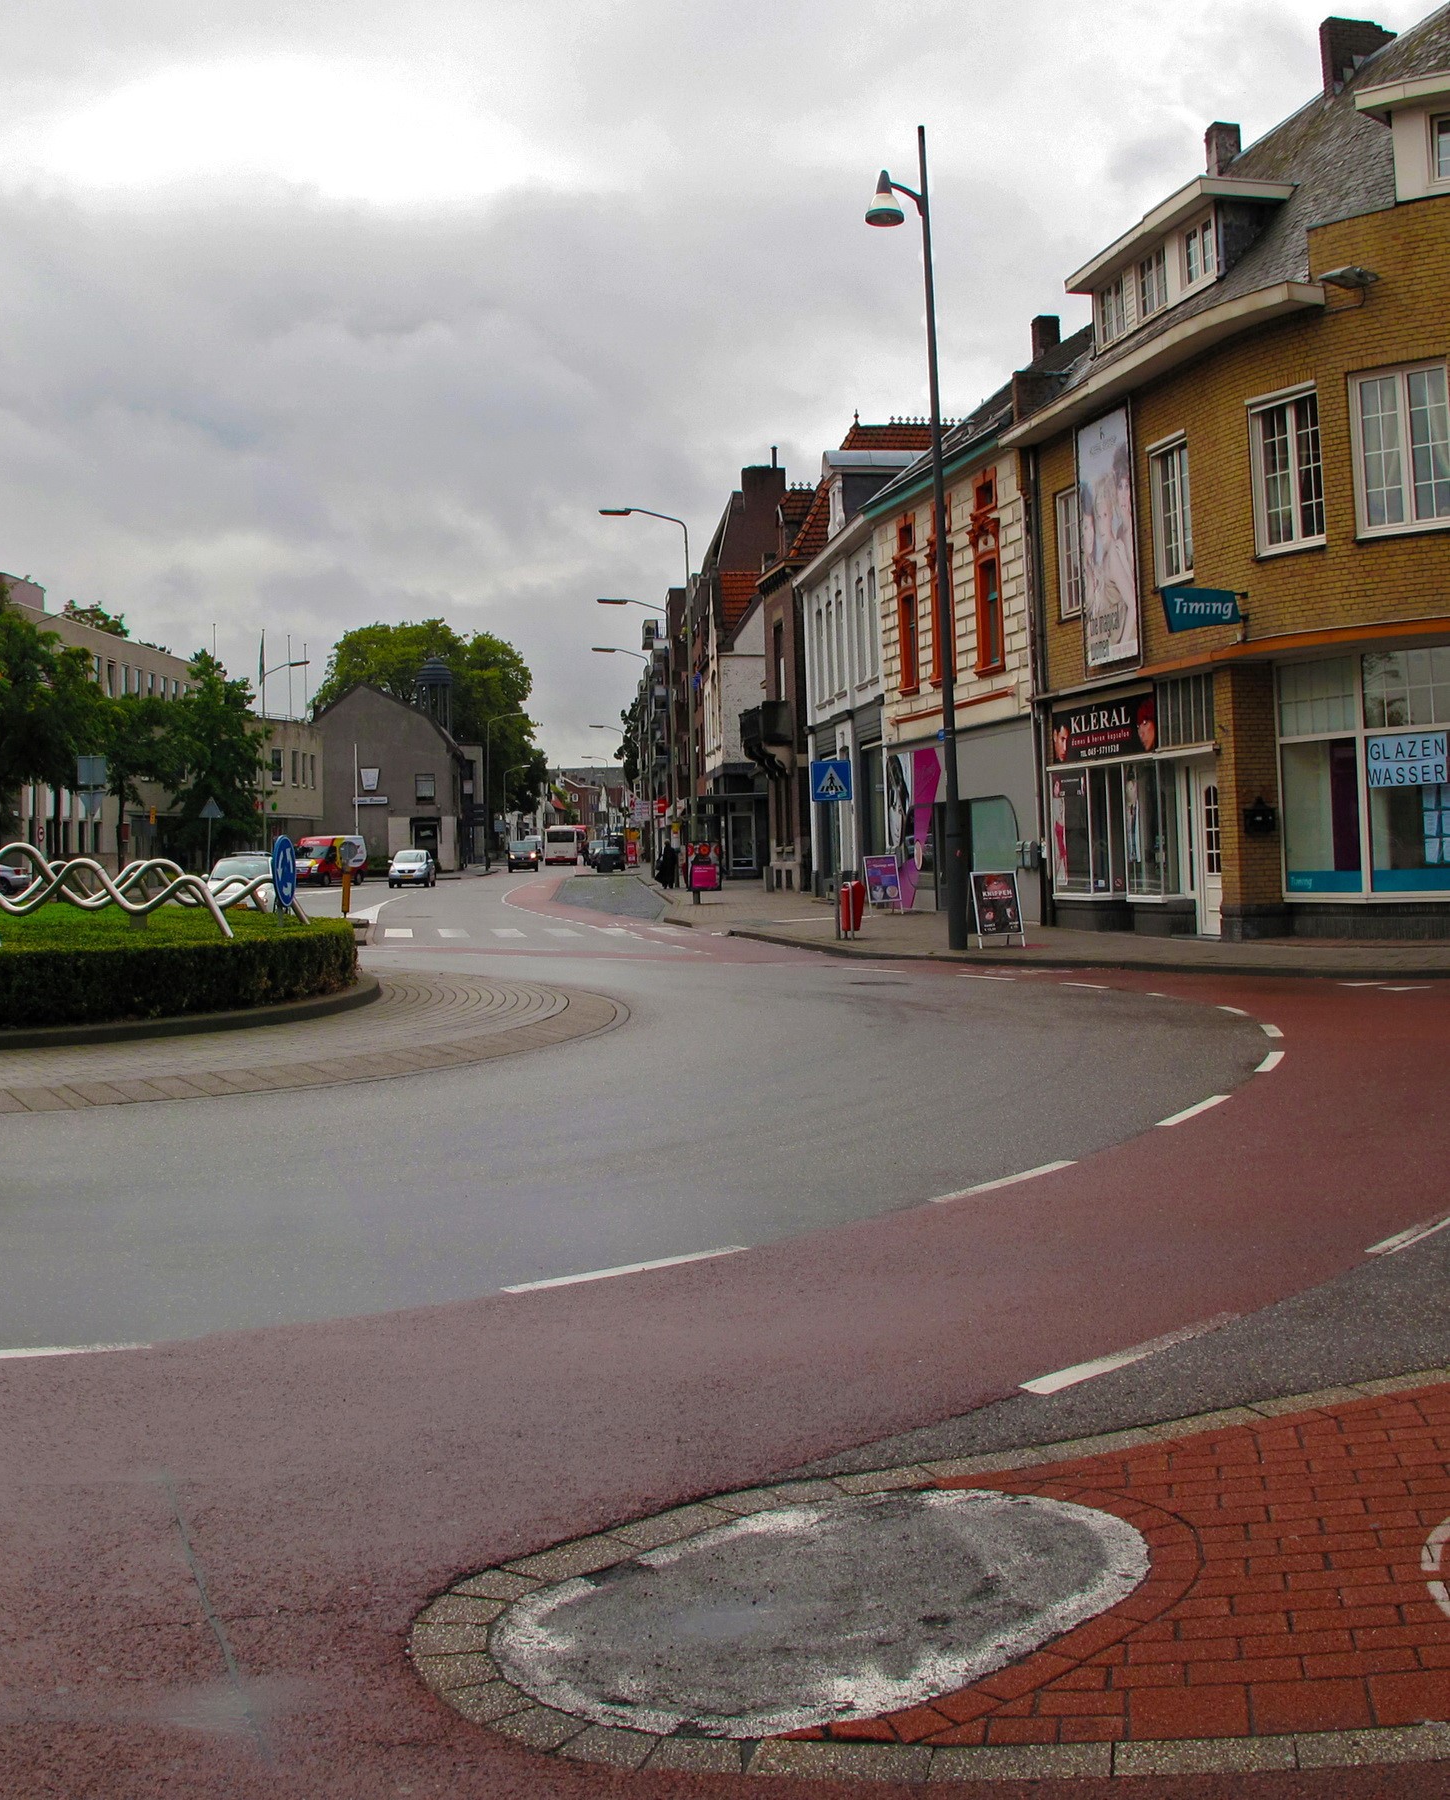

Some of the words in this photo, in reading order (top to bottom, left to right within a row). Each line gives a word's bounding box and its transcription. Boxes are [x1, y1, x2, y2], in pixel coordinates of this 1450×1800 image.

[1174, 598, 1234, 619] Timing
[1070, 705, 1130, 735] KLÉRAL
[1107, 729, 1130, 741] kapsalon
[1370, 738, 1445, 760] GLAZEN
[1368, 764, 1445, 785] WASSER
[982, 889, 1013, 897] KNIPPEN
